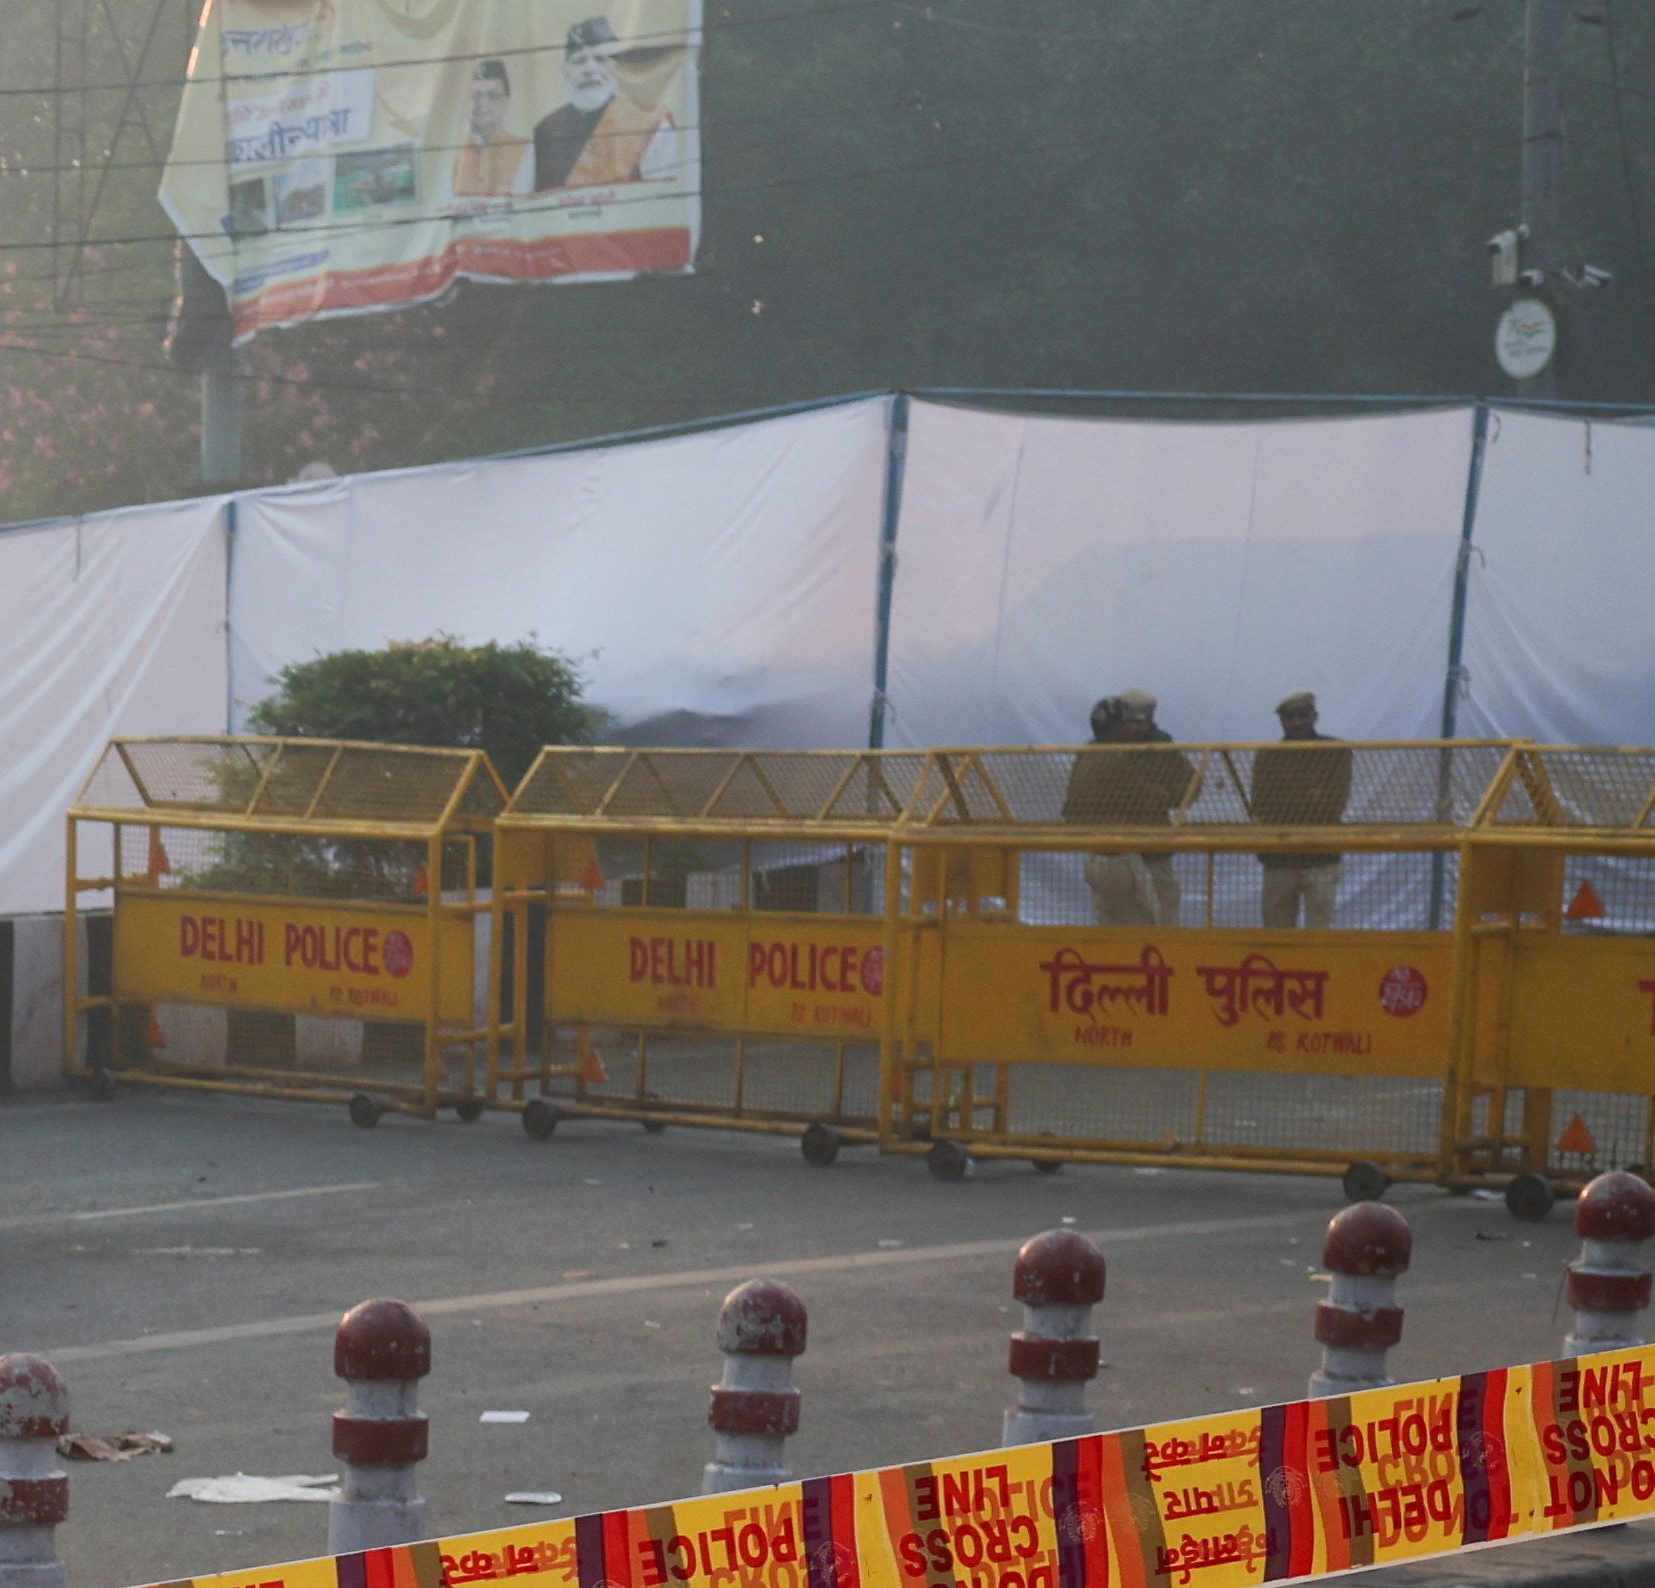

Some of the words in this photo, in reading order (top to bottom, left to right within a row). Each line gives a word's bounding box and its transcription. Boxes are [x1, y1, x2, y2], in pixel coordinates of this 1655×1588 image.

[181, 914, 265, 965] DELHI
[284, 922, 380, 975] POLICE
[630, 936, 715, 988] DELHI
[749, 940, 857, 992] POLICE
[1039, 944, 1175, 1021] दिल्ली
[1196, 954, 1330, 1027] पुलिस
[1074, 1025, 1133, 1047] NORTH
[1296, 1031, 1372, 1055] KOTWALI
[1560, 1361, 1642, 1412] LINE
[1142, 1438, 1190, 1482] करें
[1199, 1433, 1227, 1462] न
[1314, 1408, 1453, 1474] POLICE
[915, 1464, 1013, 1521] LINE
[1163, 1487, 1219, 1521] पार
[1338, 1479, 1452, 1539] DELHI
[1544, 1465, 1618, 1518] NOT
[507, 1544, 539, 1575] न
[638, 1517, 797, 1587] POLICE
[899, 1515, 1039, 1578] CROSS
[1155, 1533, 1242, 1585] लाईन
